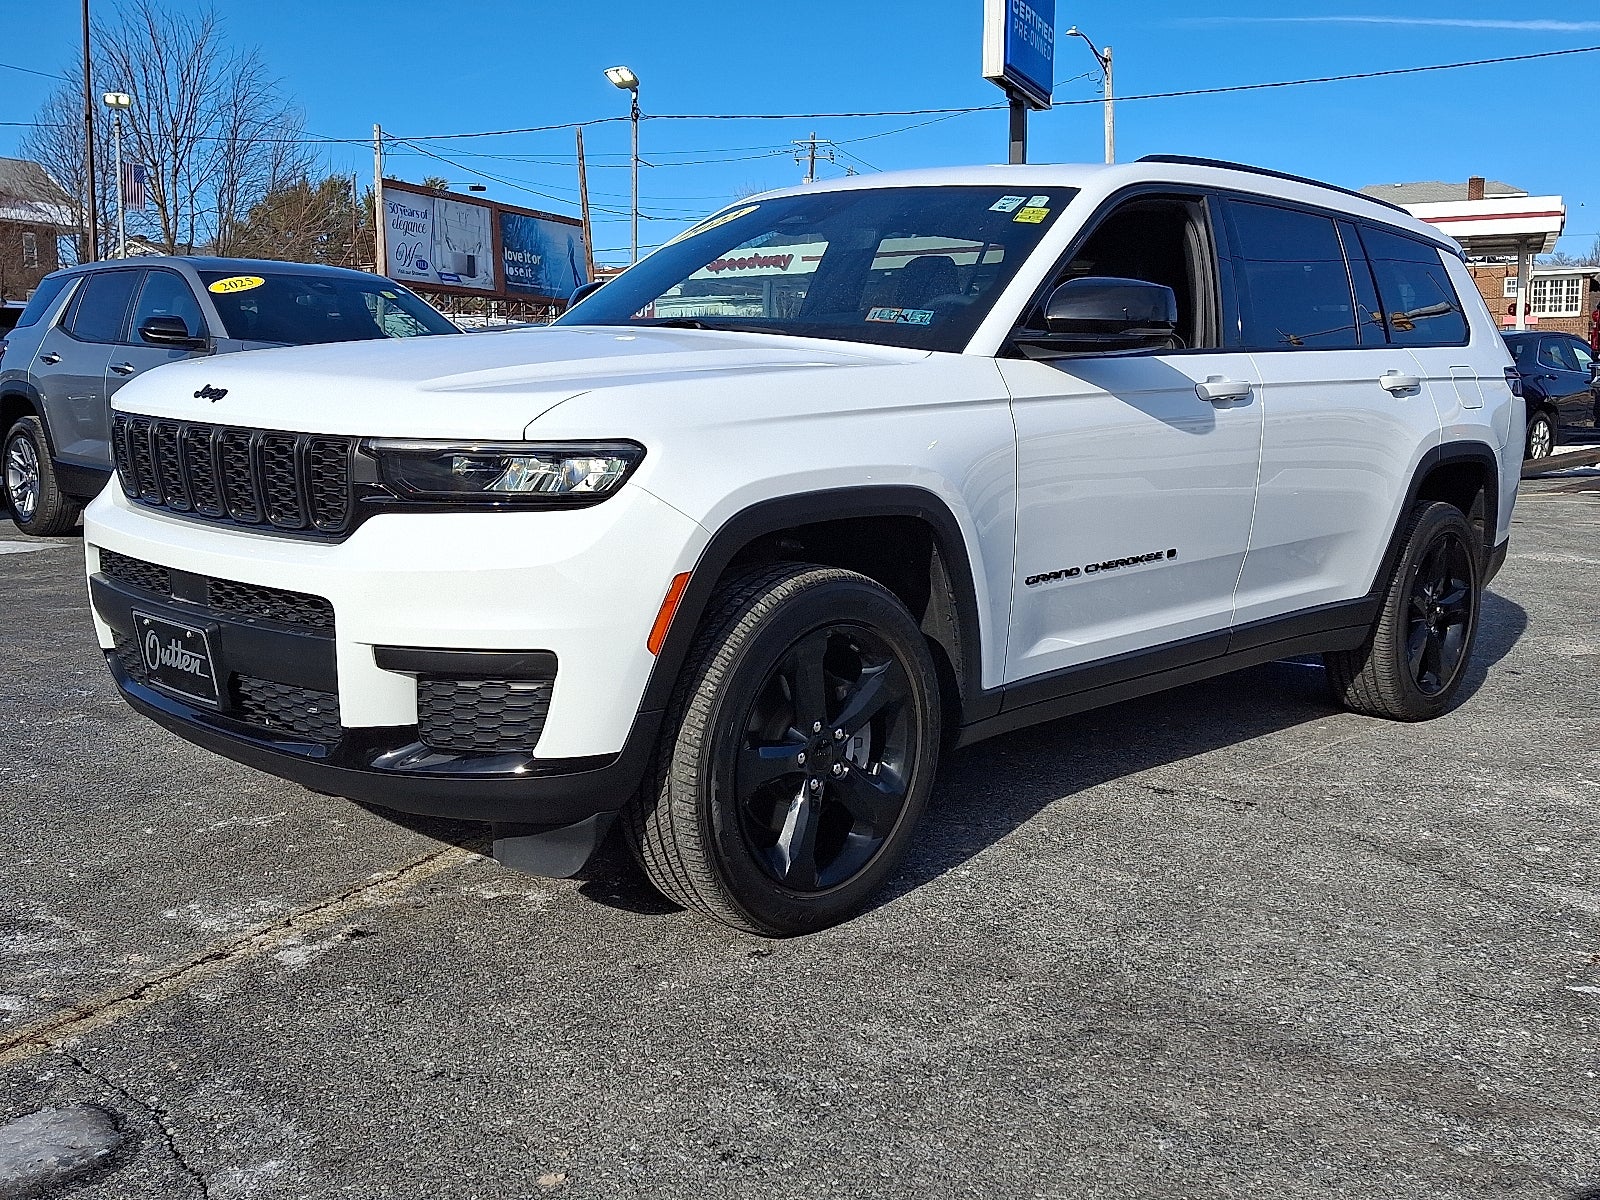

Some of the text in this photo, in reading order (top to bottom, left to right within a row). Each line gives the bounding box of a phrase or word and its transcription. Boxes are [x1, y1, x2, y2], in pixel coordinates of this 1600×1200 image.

[1012, 0, 1054, 43] CERTIFIED
[1014, 18, 1052, 60] PRE-OWNED
[392, 214, 427, 237] elegance
[420, 209, 428, 220] of
[504, 246, 542, 265] love it or
[505, 262, 533, 278] lose it
[219, 277, 254, 291] 2025
[193, 383, 229, 404] Jeep
[1025, 566, 1081, 587] GRAND
[1084, 551, 1164, 575] CHEROKEE
[145, 629, 210, 679] Outten
